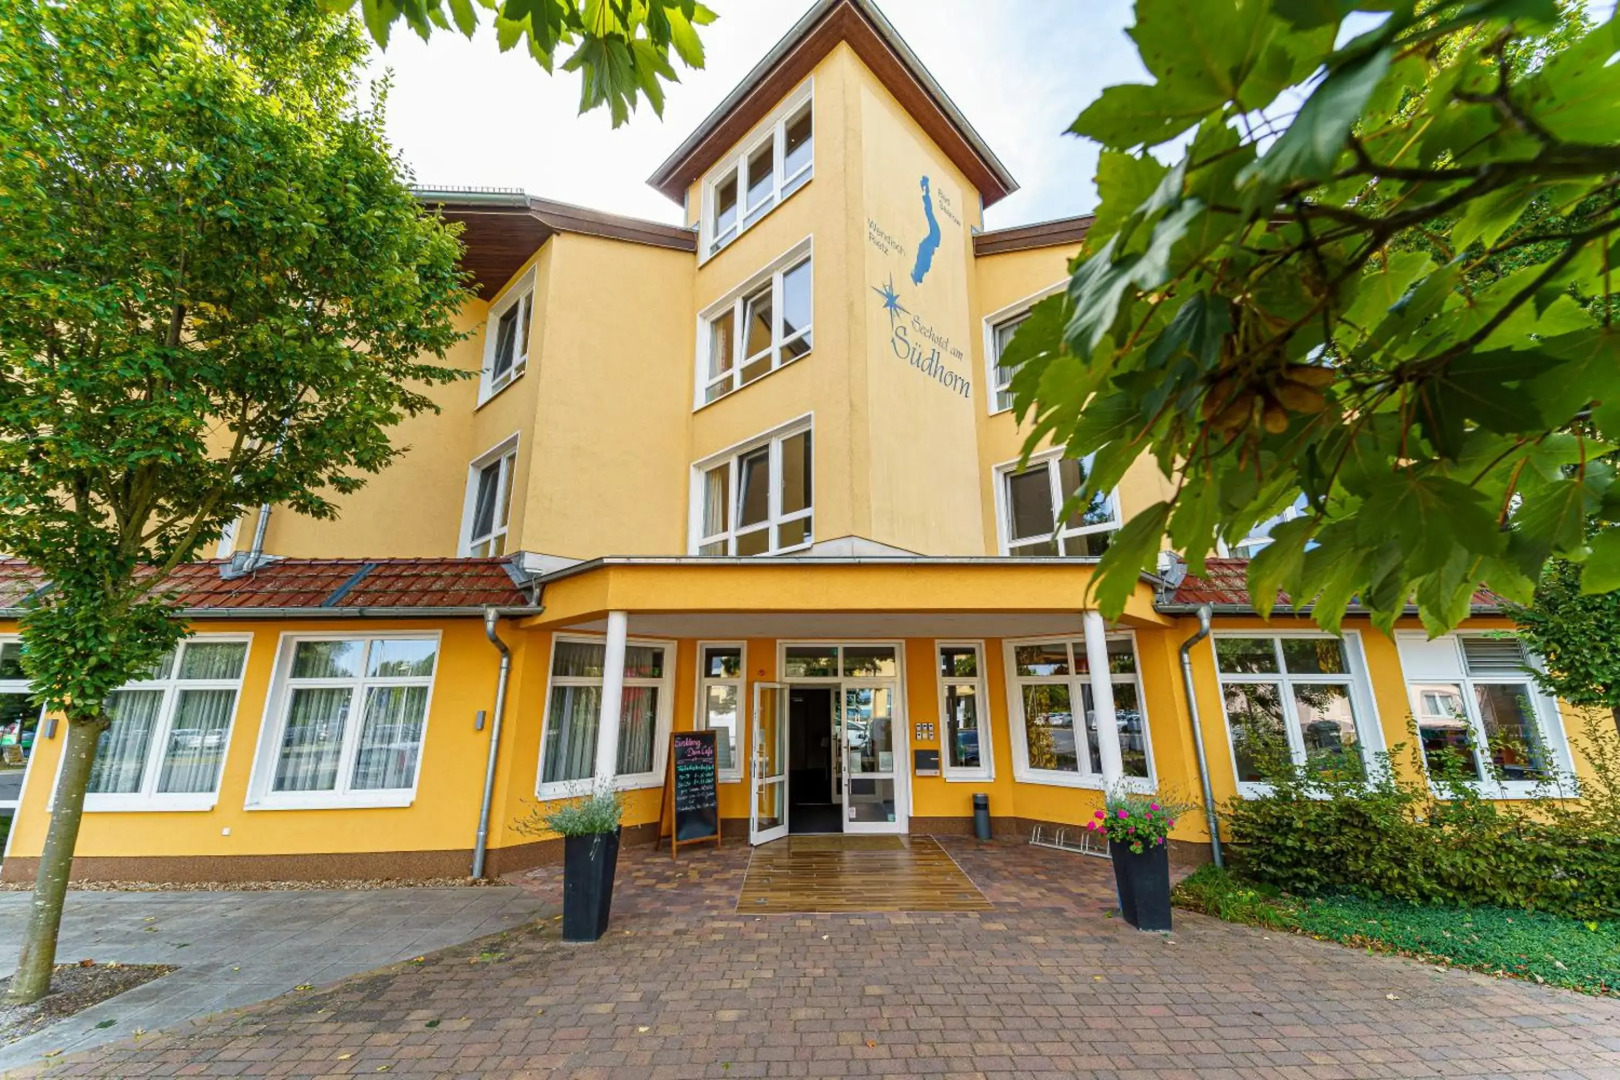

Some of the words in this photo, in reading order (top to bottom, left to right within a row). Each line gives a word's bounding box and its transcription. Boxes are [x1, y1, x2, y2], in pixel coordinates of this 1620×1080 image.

[868, 217, 906, 256] Wendisch
[869, 231, 889, 256] Rietz
[911, 315, 949, 352] Seehotel
[950, 347, 963, 362] am
[891, 325, 970, 398] Südhorn
